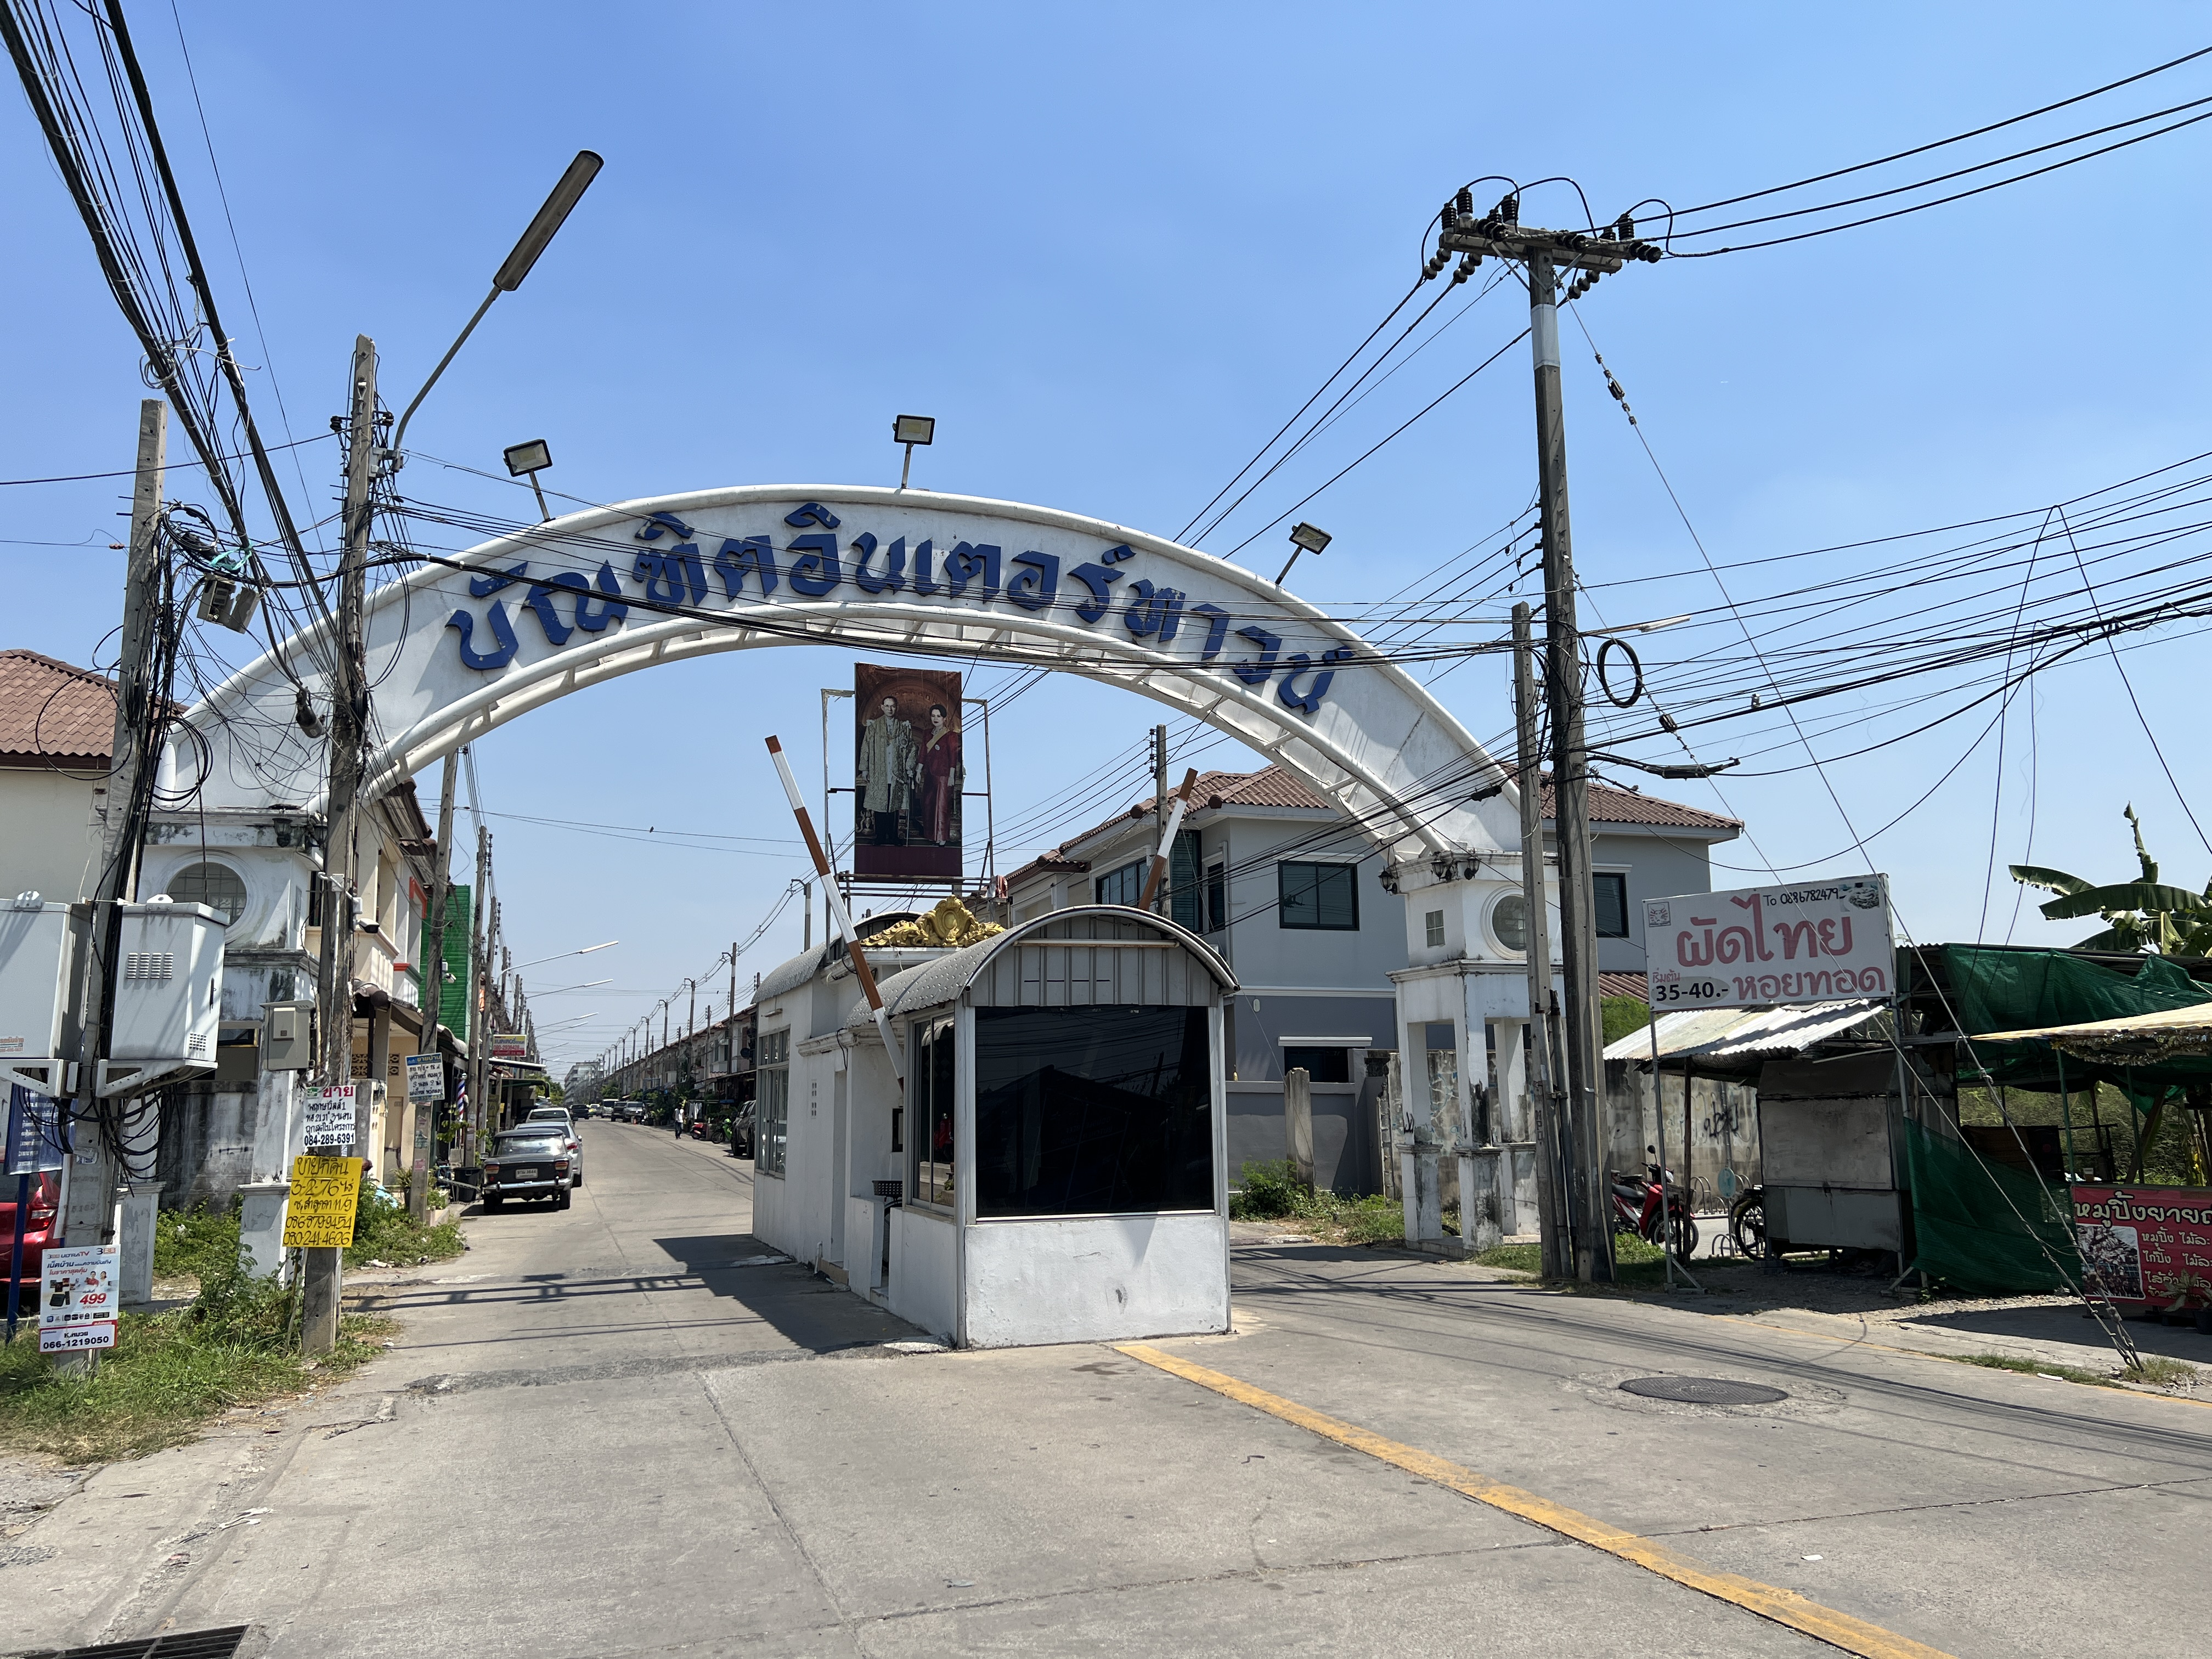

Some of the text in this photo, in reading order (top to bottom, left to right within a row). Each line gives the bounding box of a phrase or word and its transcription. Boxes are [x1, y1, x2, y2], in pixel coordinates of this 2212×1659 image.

[1780, 888, 1839, 905] 0886782479
[1677, 893, 1853, 967] ผัดไทย
[1652, 967, 1680, 983] เริ่มต้น
[1733, 966, 1886, 1000] หอยทอด
[323, 1086, 353, 1097] ขาย
[304, 1133, 354, 1146] 084-289-6391
[2142, 1226, 2210, 1247] หมูปิ้ง ไม้ละ
[80, 1293, 106, 1305] 499
[43, 1336, 109, 1349] 066-1219050
